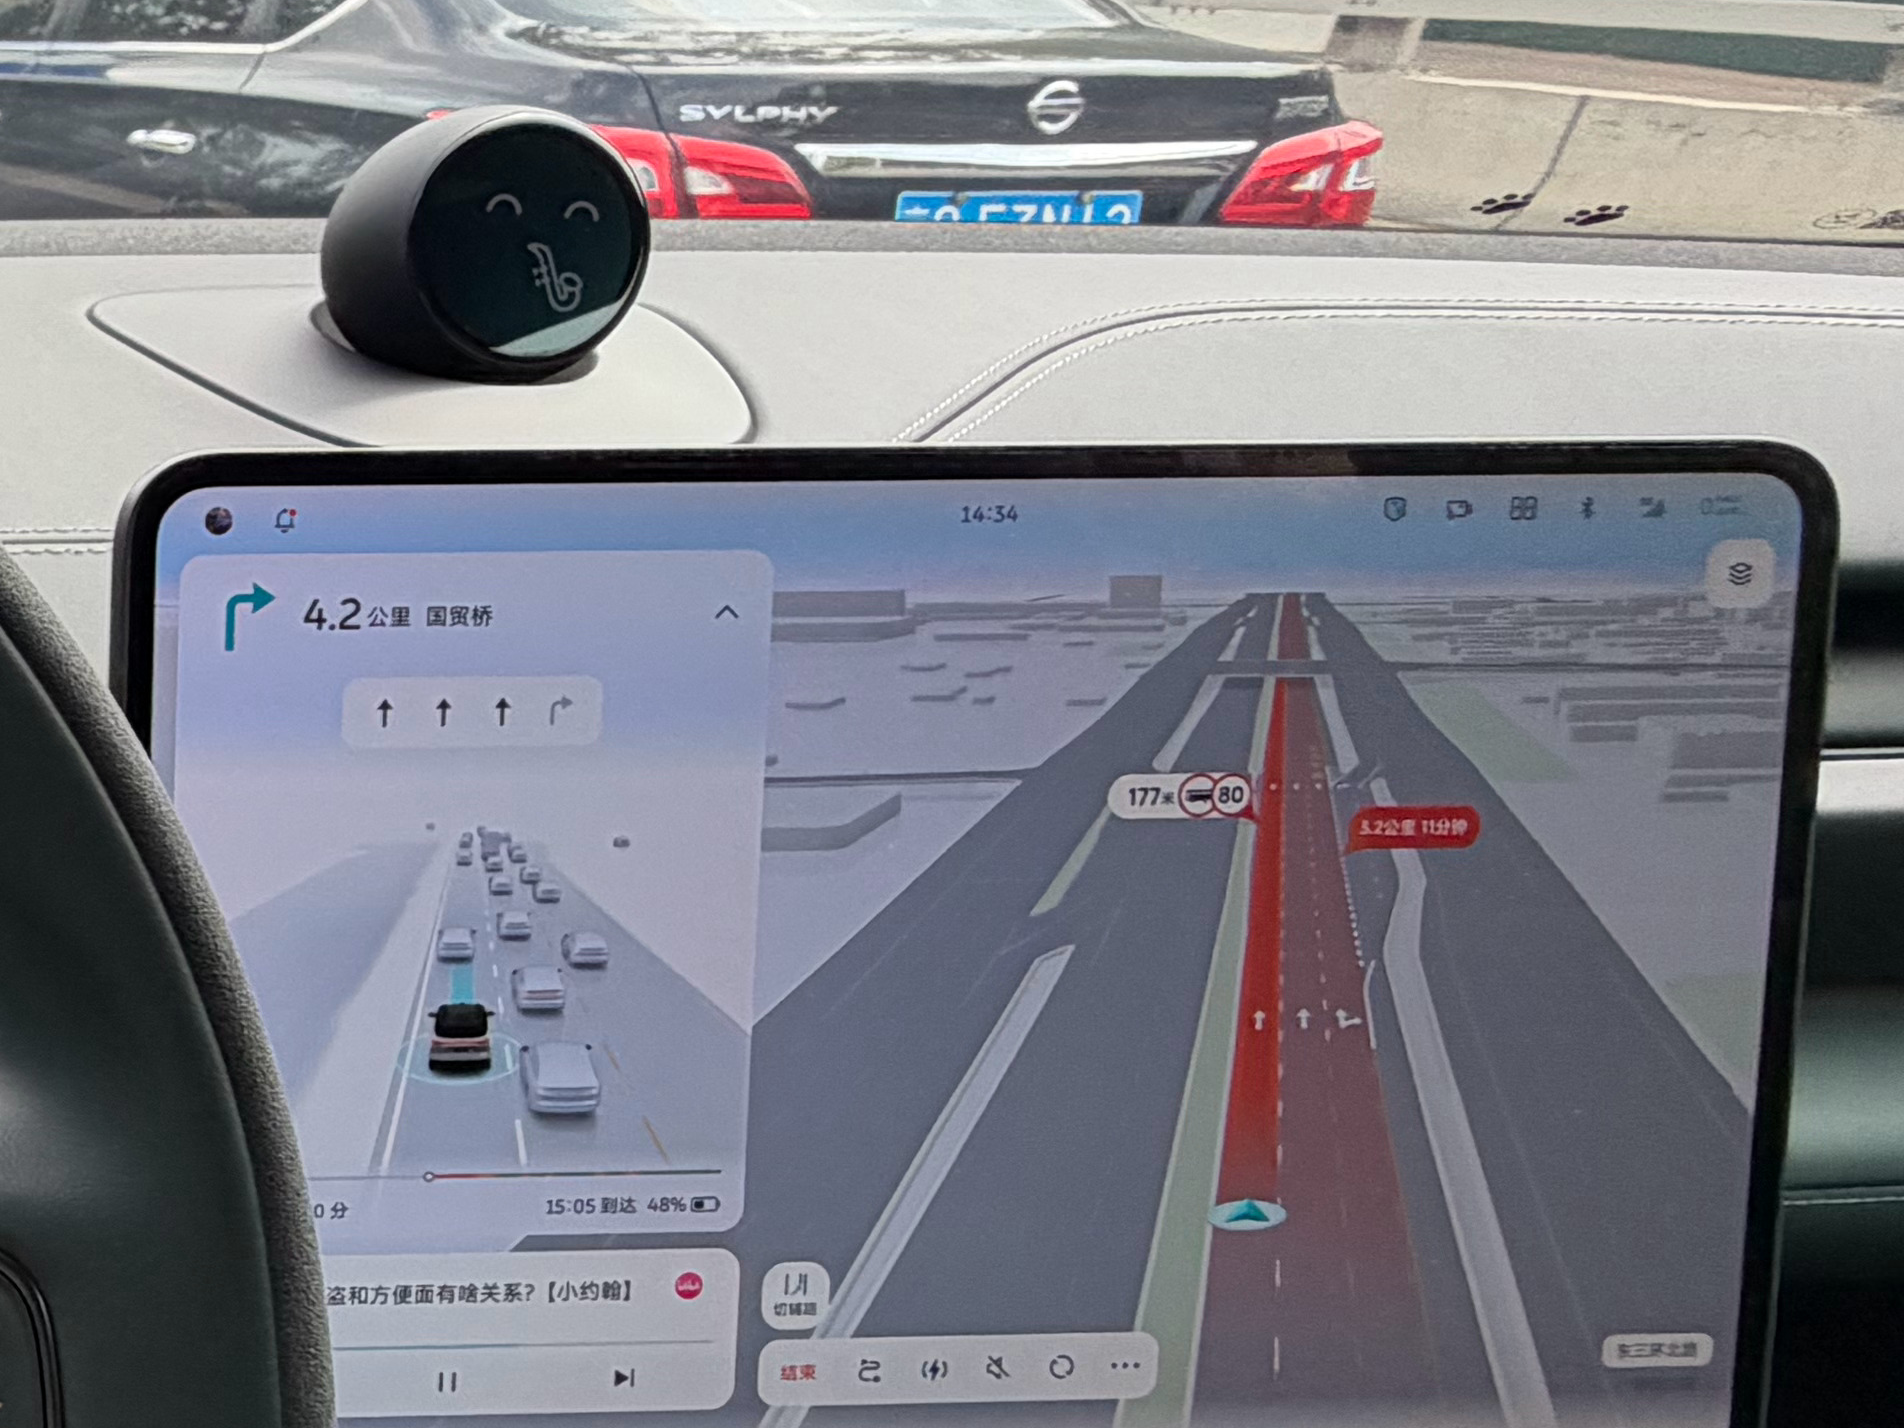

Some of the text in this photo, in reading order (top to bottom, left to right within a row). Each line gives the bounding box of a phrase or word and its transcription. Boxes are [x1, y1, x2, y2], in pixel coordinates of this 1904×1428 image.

[679, 101, 839, 126] SYLPHY
[960, 504, 1019, 524] 14:34
[426, 605, 494, 629] 国贸桥
[1218, 785, 1245, 804] 80
[546, 1196, 687, 1216] 15:05 到达 48%
